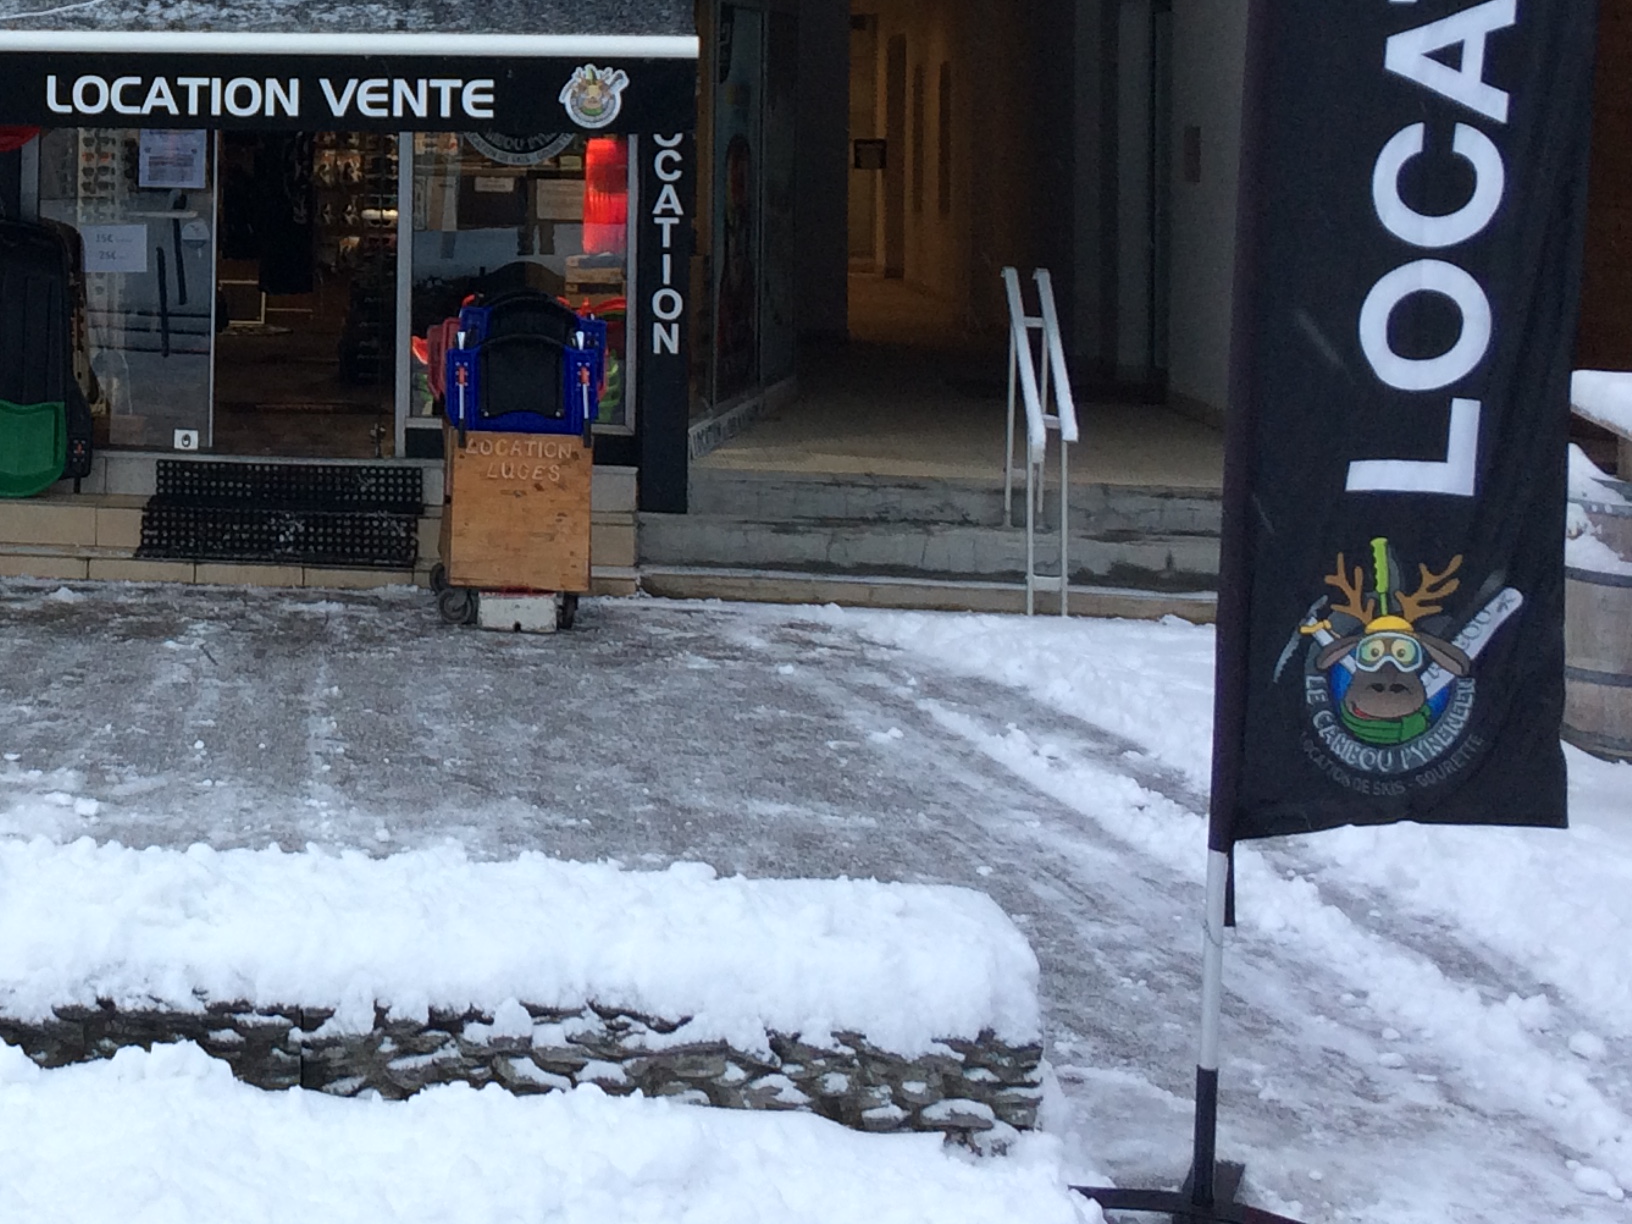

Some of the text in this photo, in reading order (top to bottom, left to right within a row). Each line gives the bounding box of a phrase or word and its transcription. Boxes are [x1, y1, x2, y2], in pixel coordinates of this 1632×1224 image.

[46, 75, 495, 119] LOCATION VENTE
[652, 133, 684, 355] CATION
[465, 438, 572, 459] LOCATION
